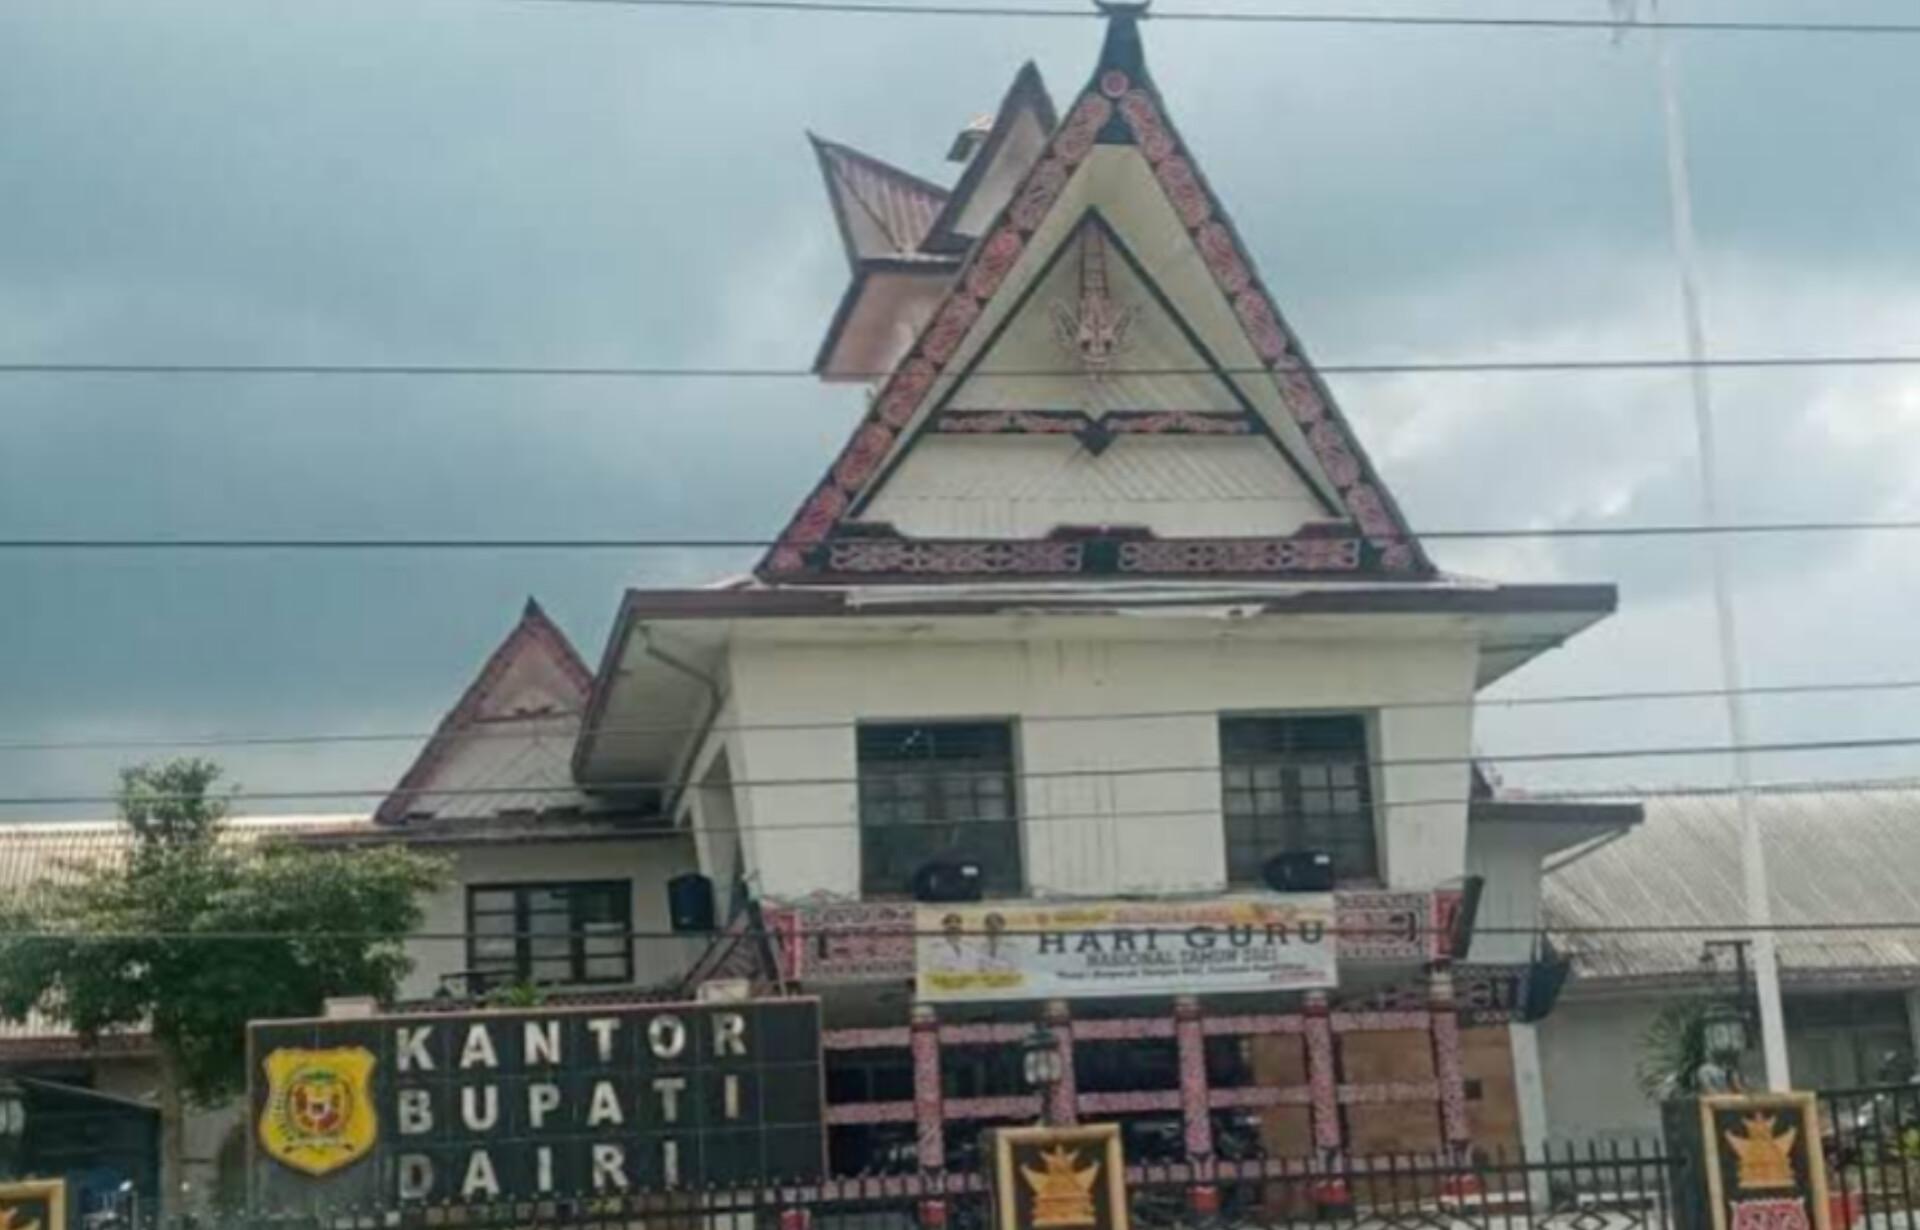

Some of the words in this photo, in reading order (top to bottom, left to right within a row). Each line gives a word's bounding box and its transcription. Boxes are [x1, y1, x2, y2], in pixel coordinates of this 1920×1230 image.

[1037, 928, 1157, 954] HARI
[1185, 920, 1325, 949] GURU
[396, 1012, 747, 1072] KANTOR
[398, 1074, 739, 1135] BUPATI
[399, 1140, 678, 1200] DAIRI
